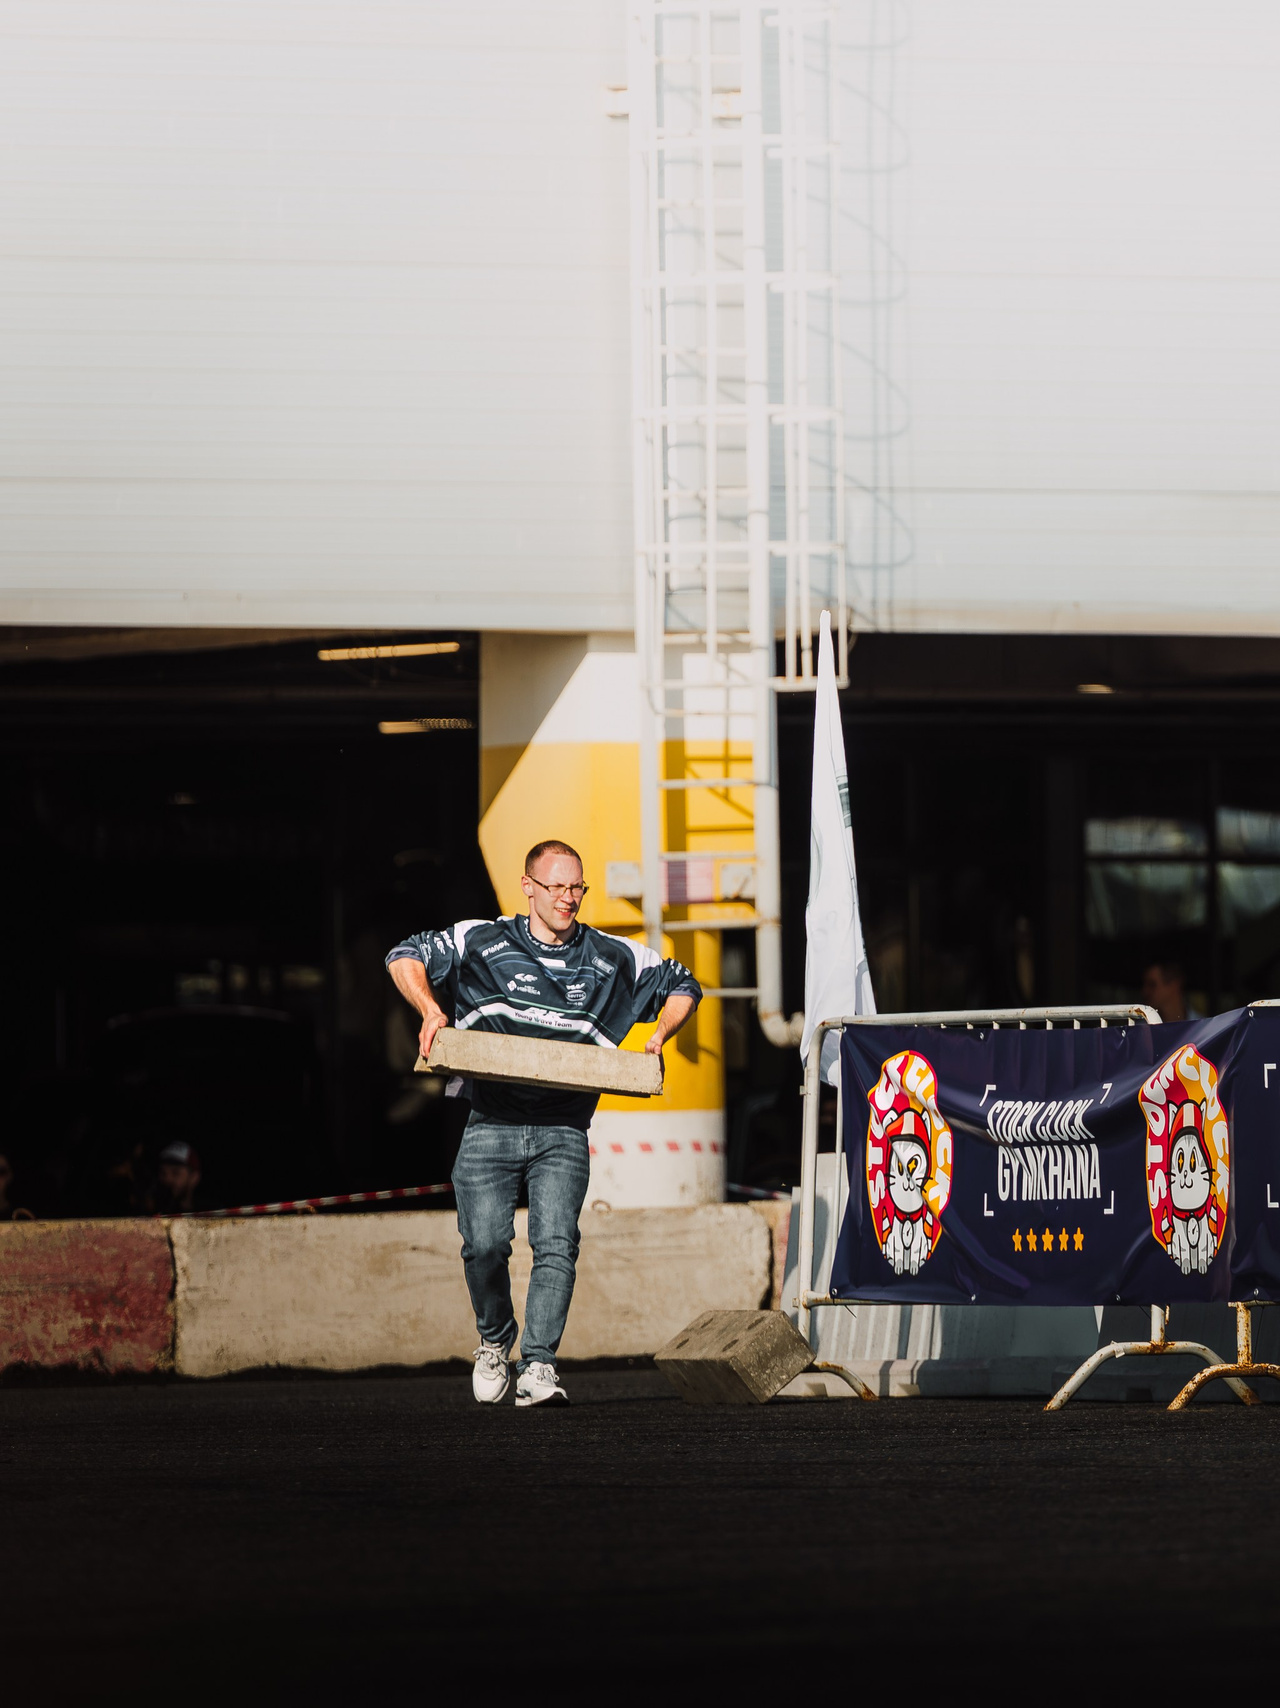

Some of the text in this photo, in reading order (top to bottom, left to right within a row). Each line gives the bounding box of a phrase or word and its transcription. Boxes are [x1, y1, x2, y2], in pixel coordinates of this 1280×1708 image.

[514, 1012, 532, 1021] Young
[554, 1020, 572, 1028] Team
[987, 1099, 1095, 1143] STOCK CLOCK
[1142, 1047, 1230, 1209] STOCK CLOCK
[998, 1143, 1101, 1201] GYMKHANA
